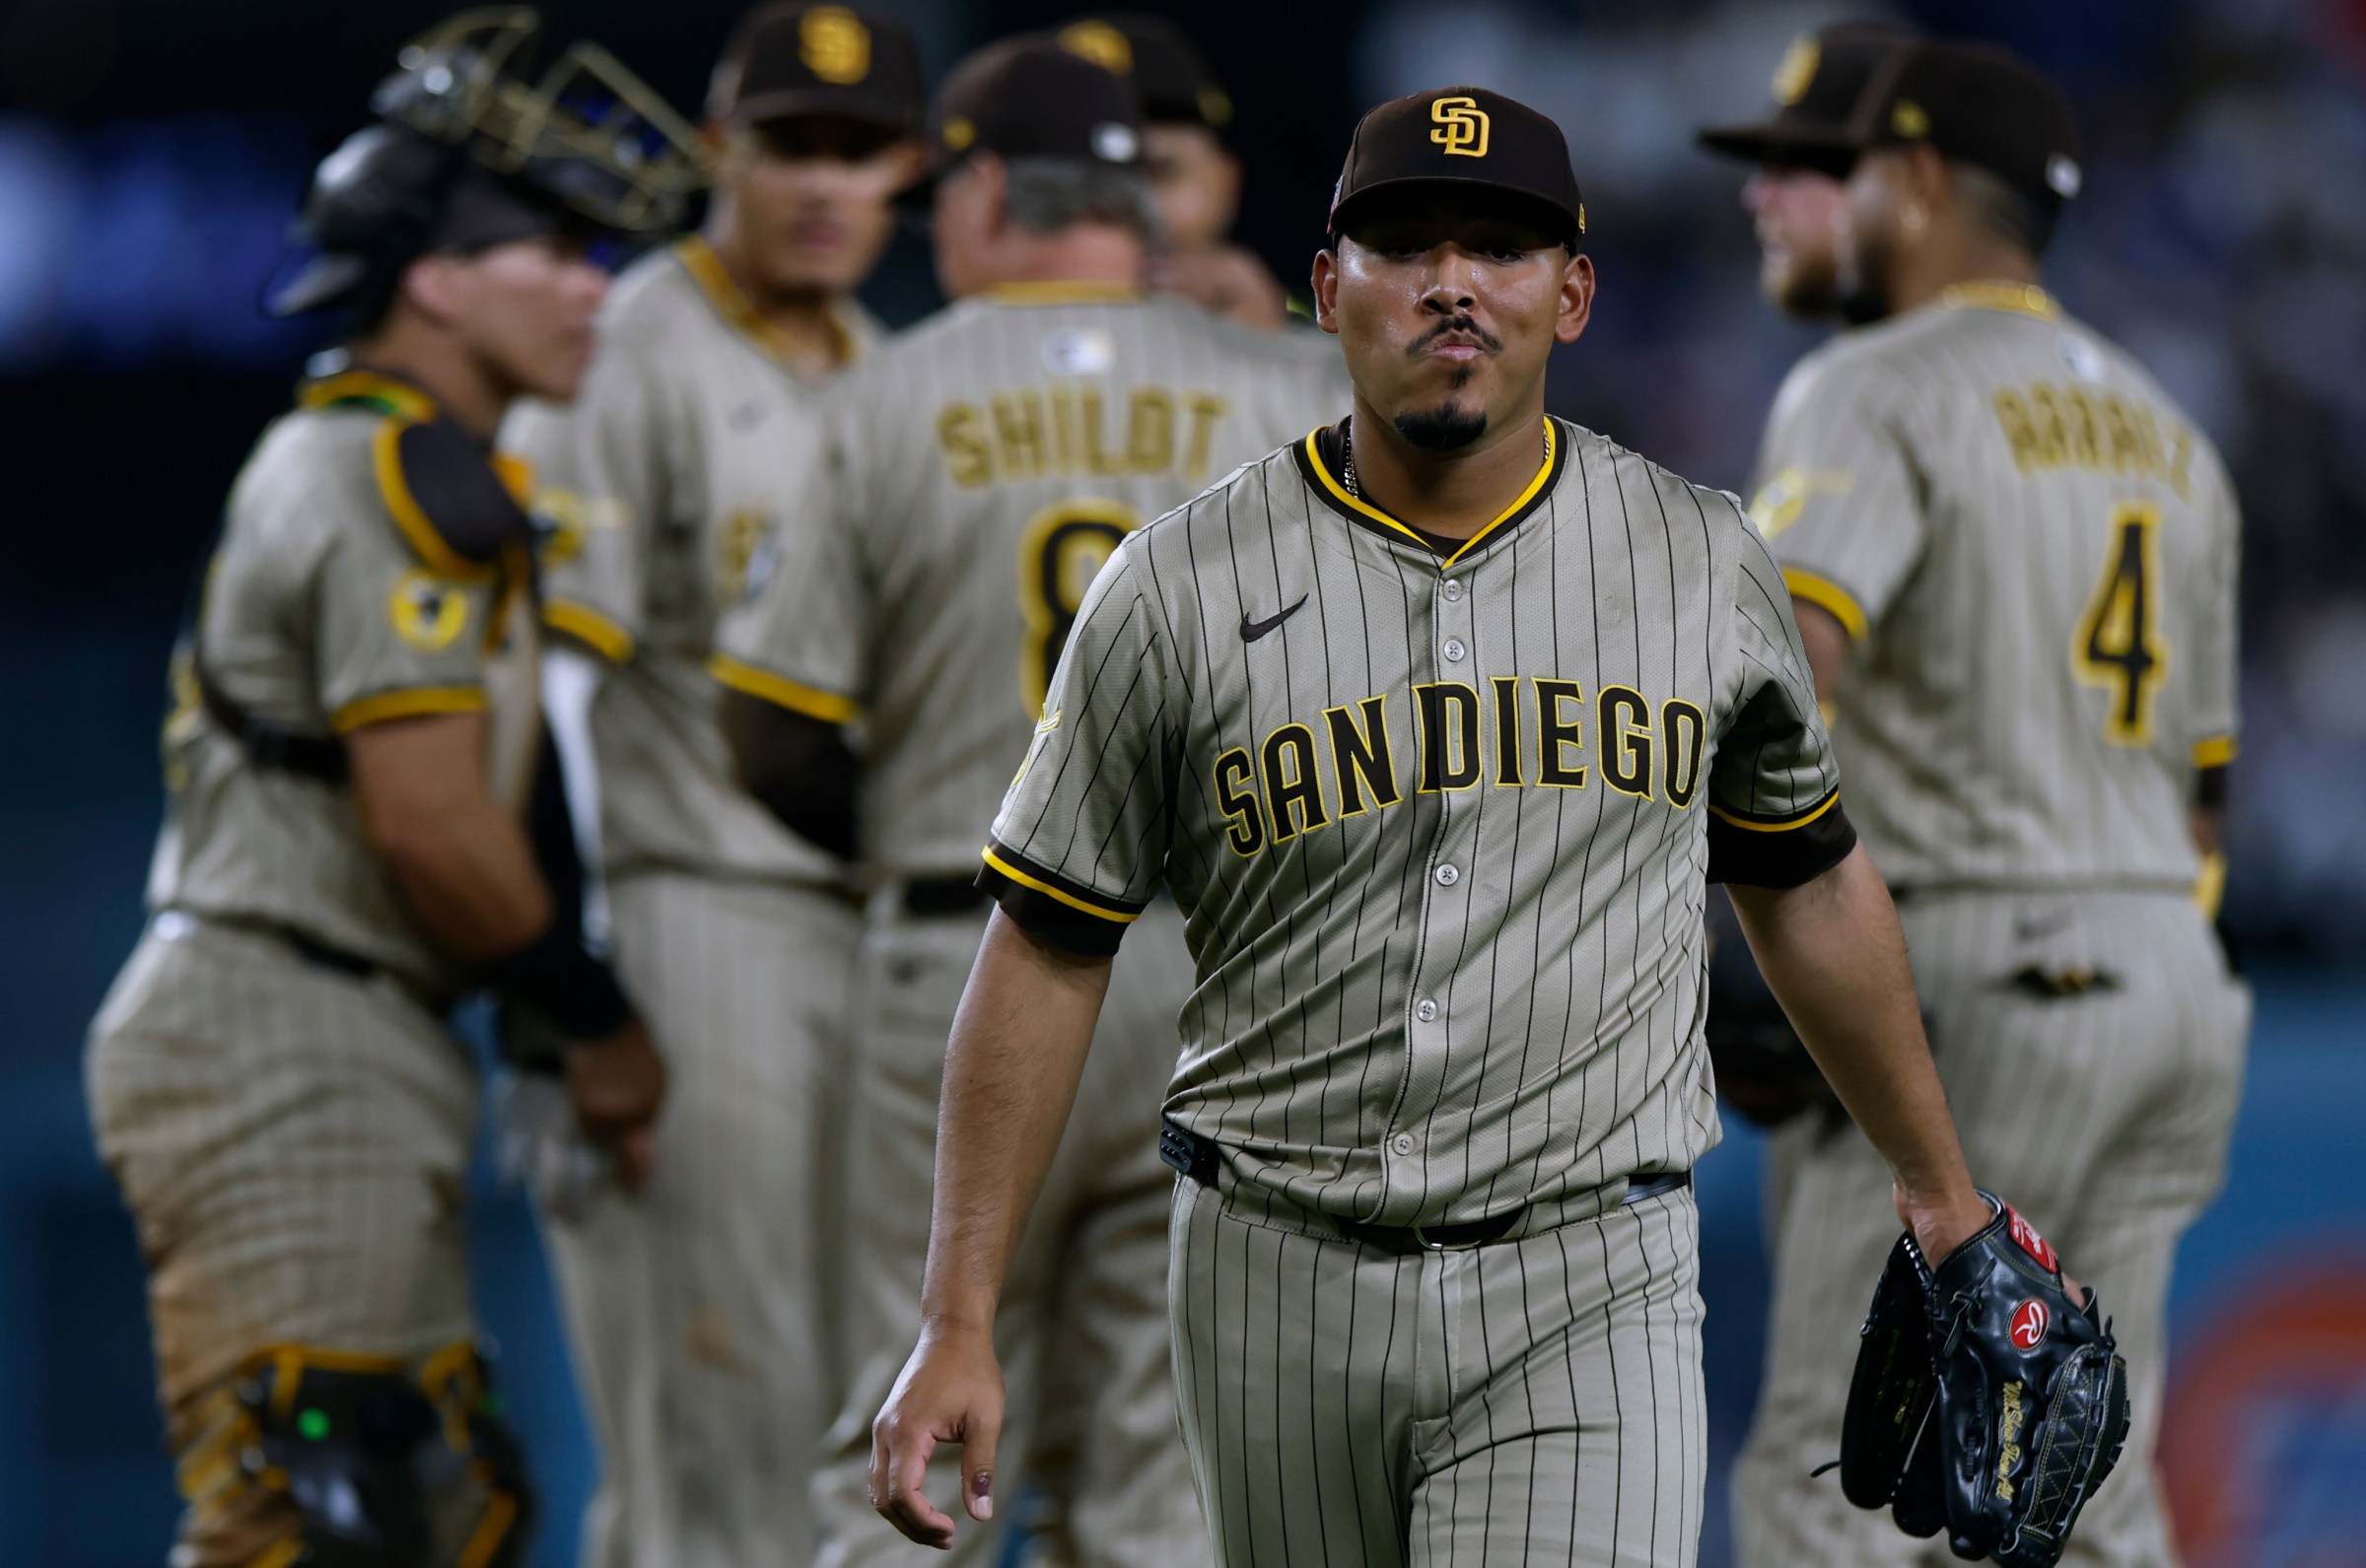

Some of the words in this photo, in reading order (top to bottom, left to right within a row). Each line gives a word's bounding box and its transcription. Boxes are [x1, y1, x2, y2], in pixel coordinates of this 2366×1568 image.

[1430, 97, 1490, 158] SD
[938, 385, 1227, 489] SHILDT
[2073, 503, 2169, 746] 4
[1213, 695, 1404, 857] SAN
[1412, 676, 1706, 810] DIEGO
